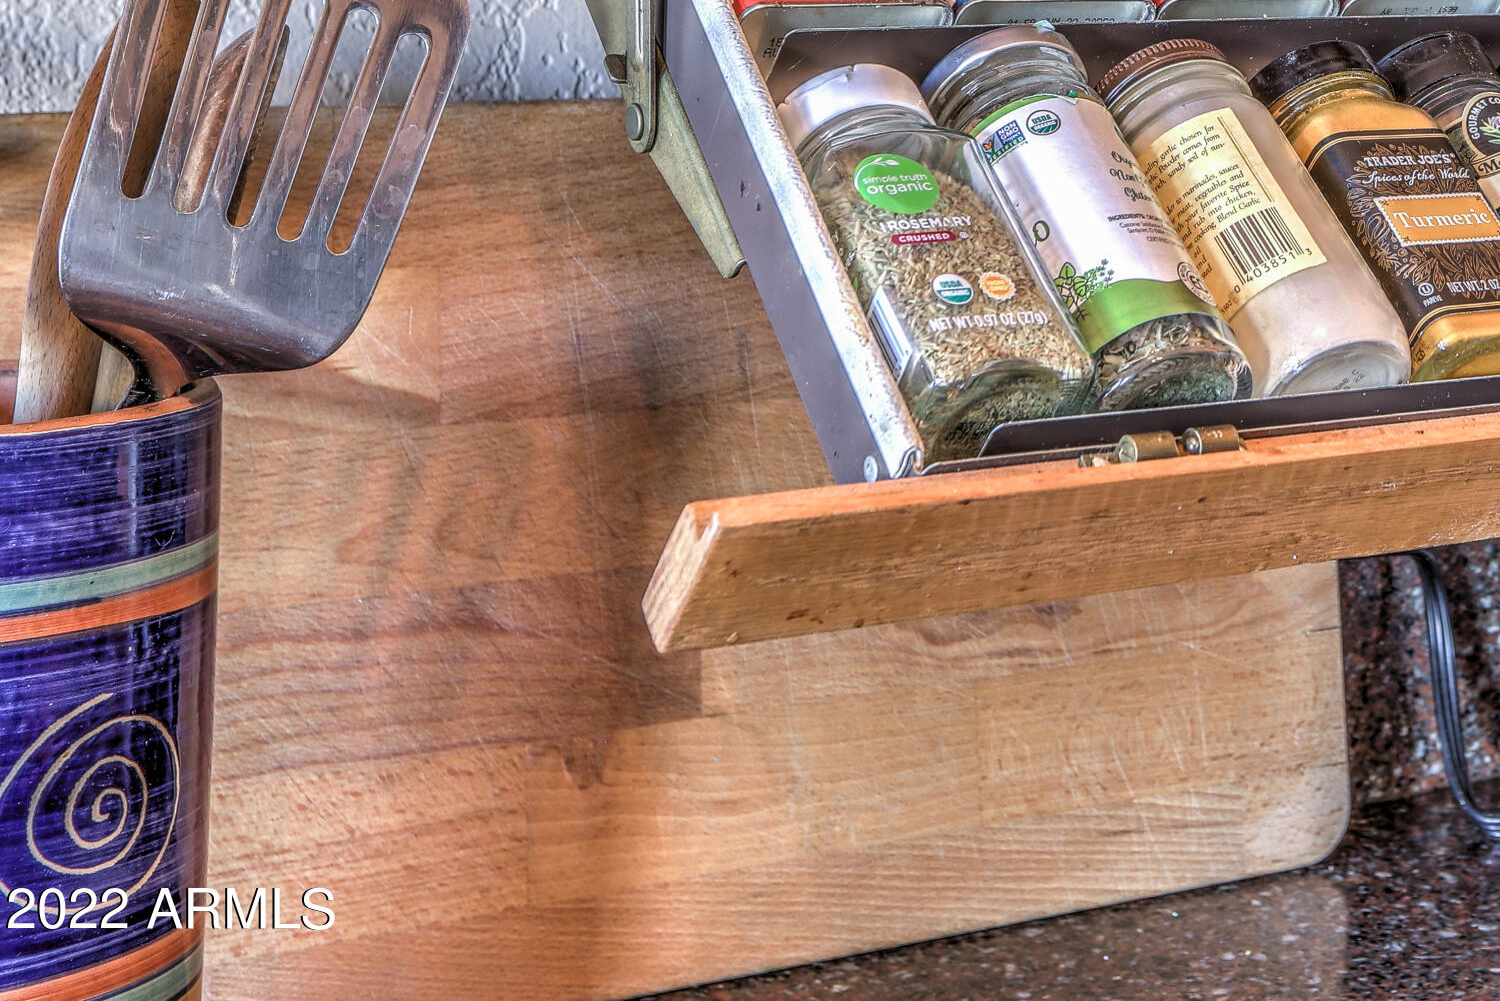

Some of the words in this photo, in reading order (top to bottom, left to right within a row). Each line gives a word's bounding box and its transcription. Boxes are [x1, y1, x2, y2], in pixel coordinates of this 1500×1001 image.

[1031, 113, 1052, 124] USDA
[1468, 99, 1488, 140] GOURMET
[998, 121, 1016, 135] NON
[1000, 126, 1019, 140] GMO
[1179, 131, 1202, 146] chosen
[1205, 125, 1215, 135] for
[1182, 142, 1203, 155] comes
[1204, 134, 1221, 147] from
[1187, 152, 1199, 163] soil
[1201, 146, 1209, 156] of
[1363, 155, 1417, 168] TRADER
[1417, 153, 1451, 166] JOE'S
[862, 174, 898, 186] simple
[899, 172, 928, 182] truth
[1194, 179, 1228, 202] vegetables
[1230, 171, 1245, 181] and
[1362, 170, 1403, 189] Spices
[1402, 170, 1416, 186] of
[1416, 169, 1436, 181] the
[1438, 167, 1471, 180] World
[866, 180, 933, 196] organic
[1200, 190, 1227, 212] favorite
[1230, 180, 1250, 196] Spice
[1194, 216, 1206, 230] rub
[1208, 205, 1222, 218] into
[1217, 208, 1238, 223] Blend
[1238, 198, 1261, 210] Garlic
[1392, 209, 1491, 230] Turmeric
[898, 233, 950, 243] CRUSHED
[1447, 281, 1464, 294] NET
[1422, 295, 1444, 308] PAREVE
[928, 318, 952, 332] NET
[952, 316, 973, 330] WT
[1002, 314, 1016, 325] OZ
[1017, 312, 1048, 326] (27g)
